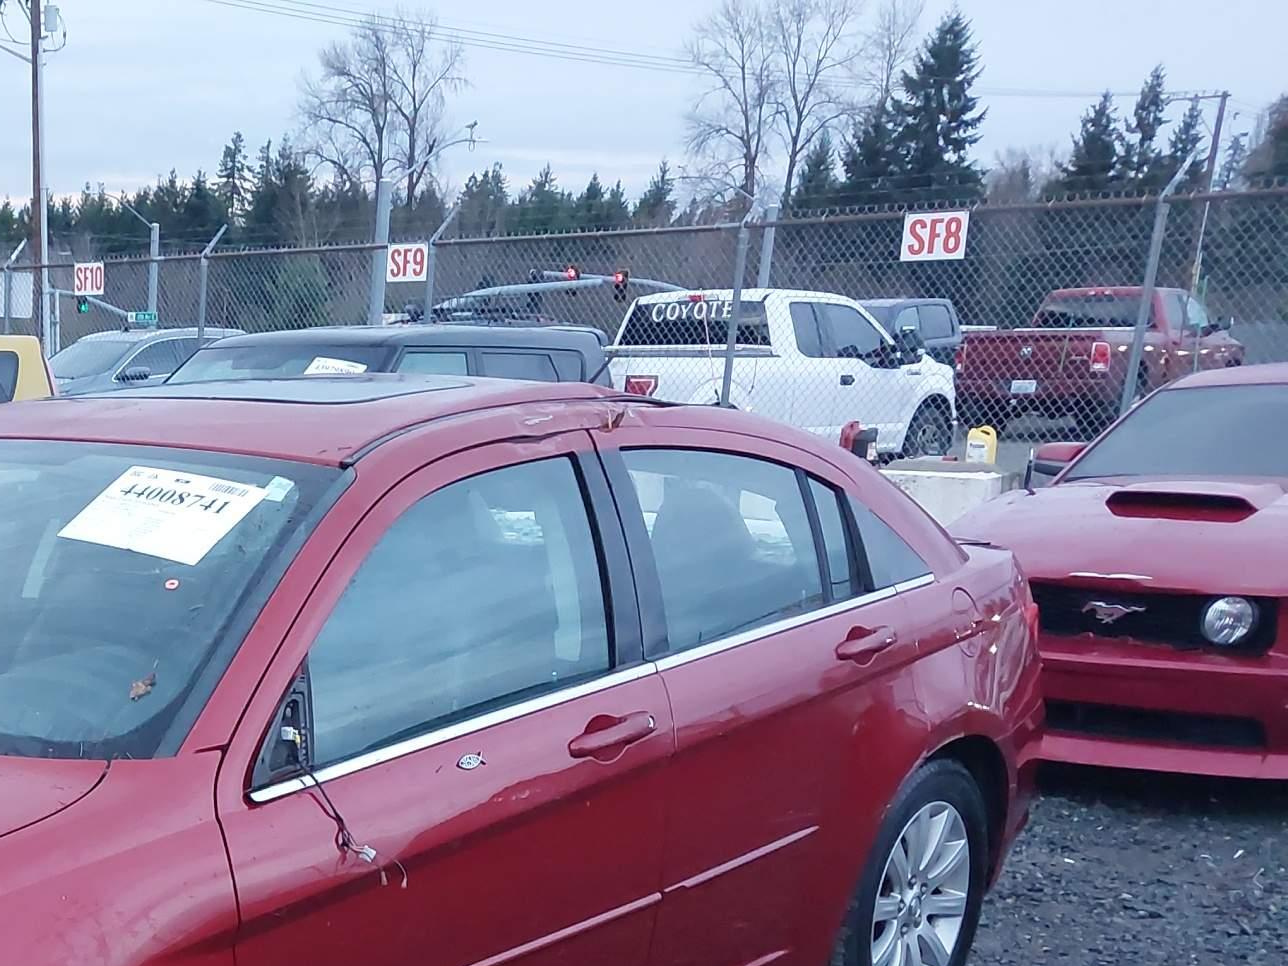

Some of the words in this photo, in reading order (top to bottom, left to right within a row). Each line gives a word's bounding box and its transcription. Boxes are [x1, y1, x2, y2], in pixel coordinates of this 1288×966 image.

[907, 216, 962, 256] SF8
[390, 247, 425, 278] SF9
[75, 265, 103, 292] SF10
[652, 300, 732, 322] COYOTE
[120, 483, 231, 514] 44008741
